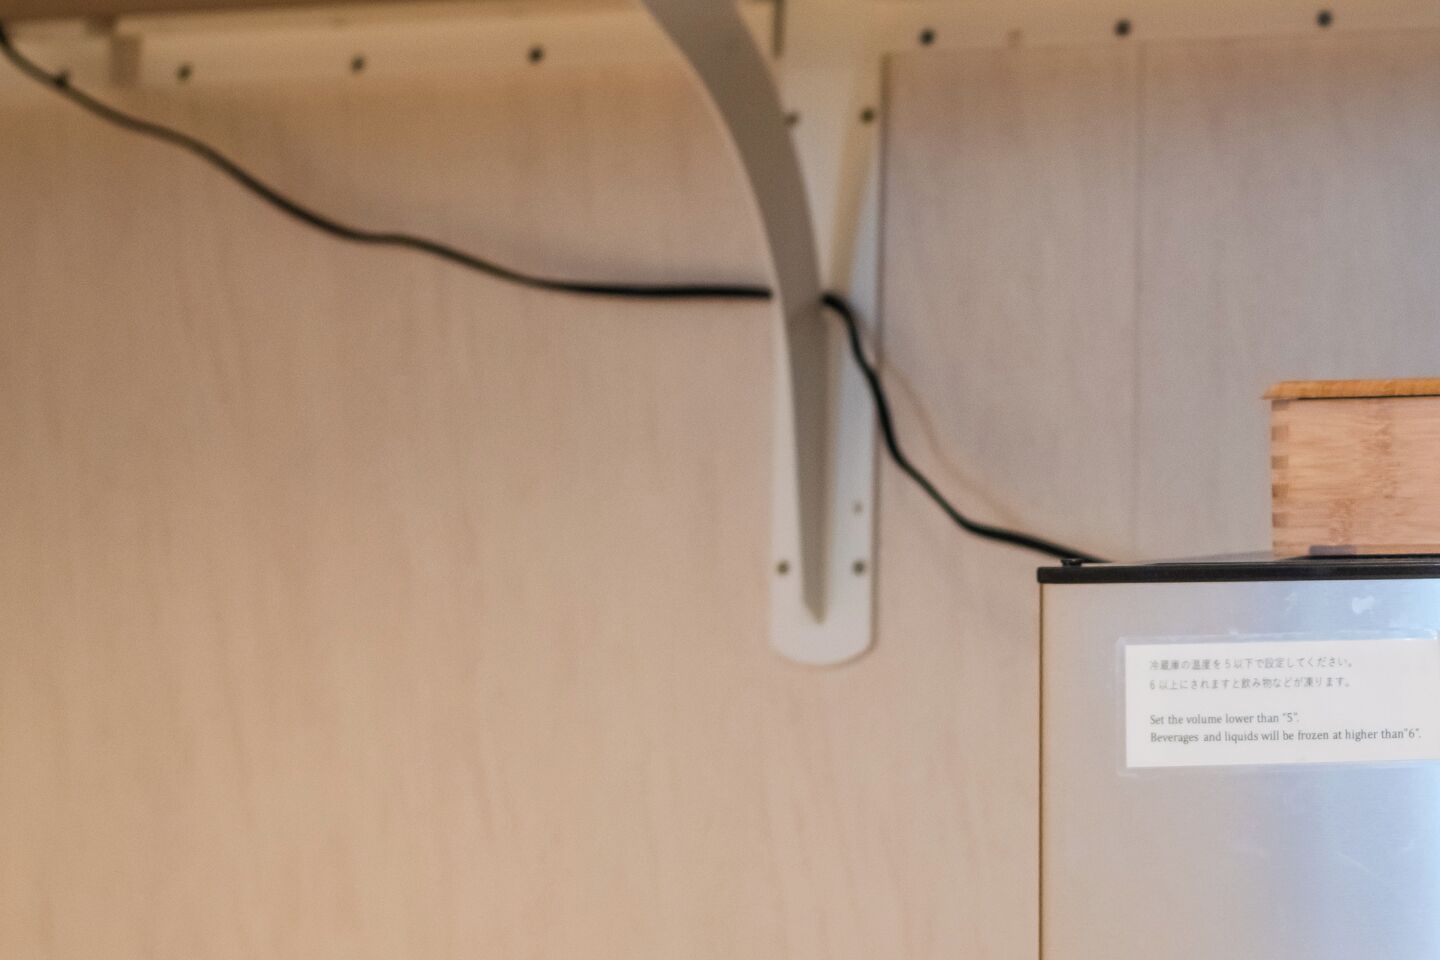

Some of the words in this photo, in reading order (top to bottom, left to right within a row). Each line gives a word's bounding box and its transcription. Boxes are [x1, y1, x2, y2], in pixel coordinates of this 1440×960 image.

[1150, 714, 1165, 725] Set
[1168, 714, 1183, 725] the
[1186, 714, 1222, 725] volume
[1225, 713, 1255, 724] lower
[1257, 712, 1279, 724] than
[1150, 732, 1199, 744] Beverages
[1203, 732, 1222, 742] and
[1224, 731, 1259, 744] liquids
[1261, 731, 1280, 741] will
[1282, 731, 1294, 740] be
[1297, 730, 1329, 740] frozen
[1332, 730, 1342, 740] at
[1345, 729, 1378, 742] higher
